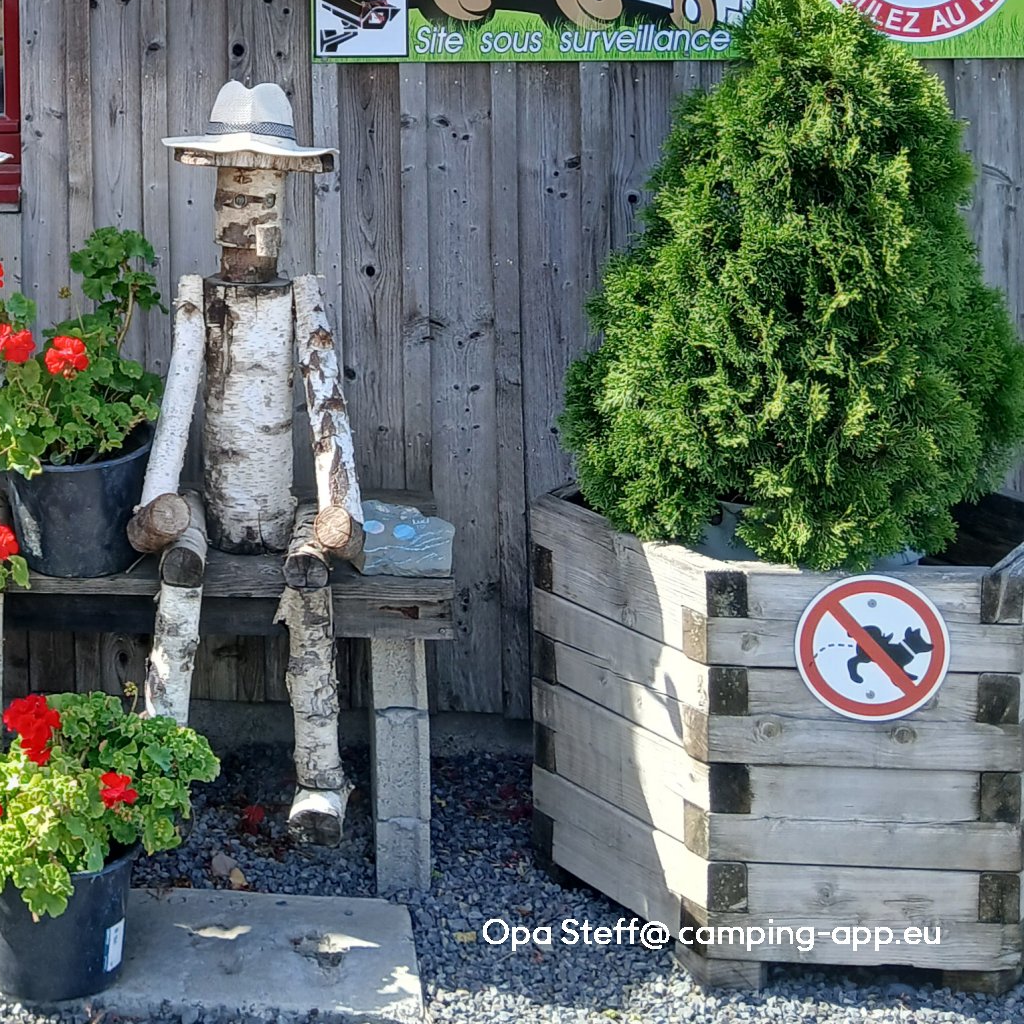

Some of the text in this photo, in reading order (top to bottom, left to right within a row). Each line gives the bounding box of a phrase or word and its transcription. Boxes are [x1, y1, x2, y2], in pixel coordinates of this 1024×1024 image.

[931, 2, 967, 32] AU
[414, 23, 732, 54] Site sous surveillance
